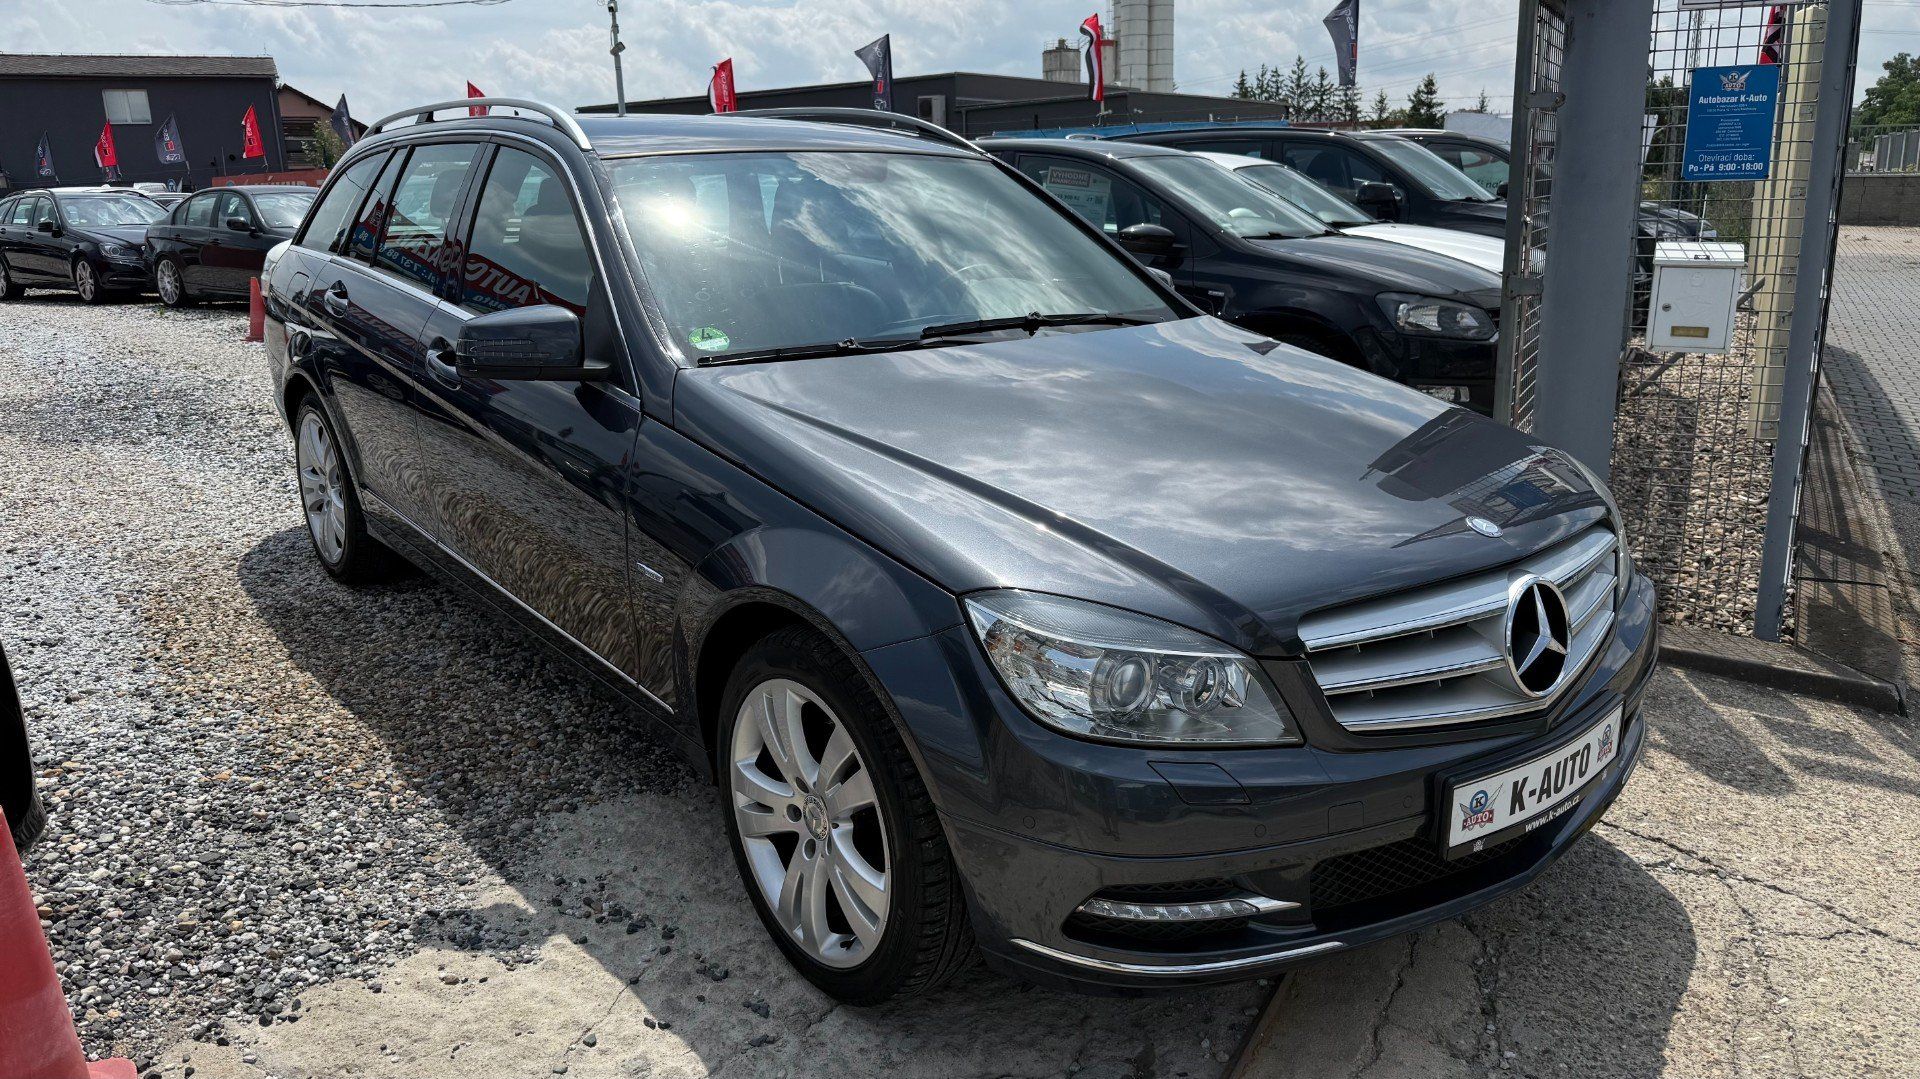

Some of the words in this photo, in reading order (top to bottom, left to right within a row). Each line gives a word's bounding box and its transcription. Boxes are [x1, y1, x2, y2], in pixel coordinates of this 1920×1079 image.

[1698, 95, 1739, 104] Autobazar
[1740, 93, 1768, 103] K-Auto
[1698, 152, 1733, 162] Otevírací
[1733, 153, 1755, 161] doba:
[1509, 742, 1592, 816] K-AUTO
[1525, 795, 1580, 832] www.k-auto.cz
